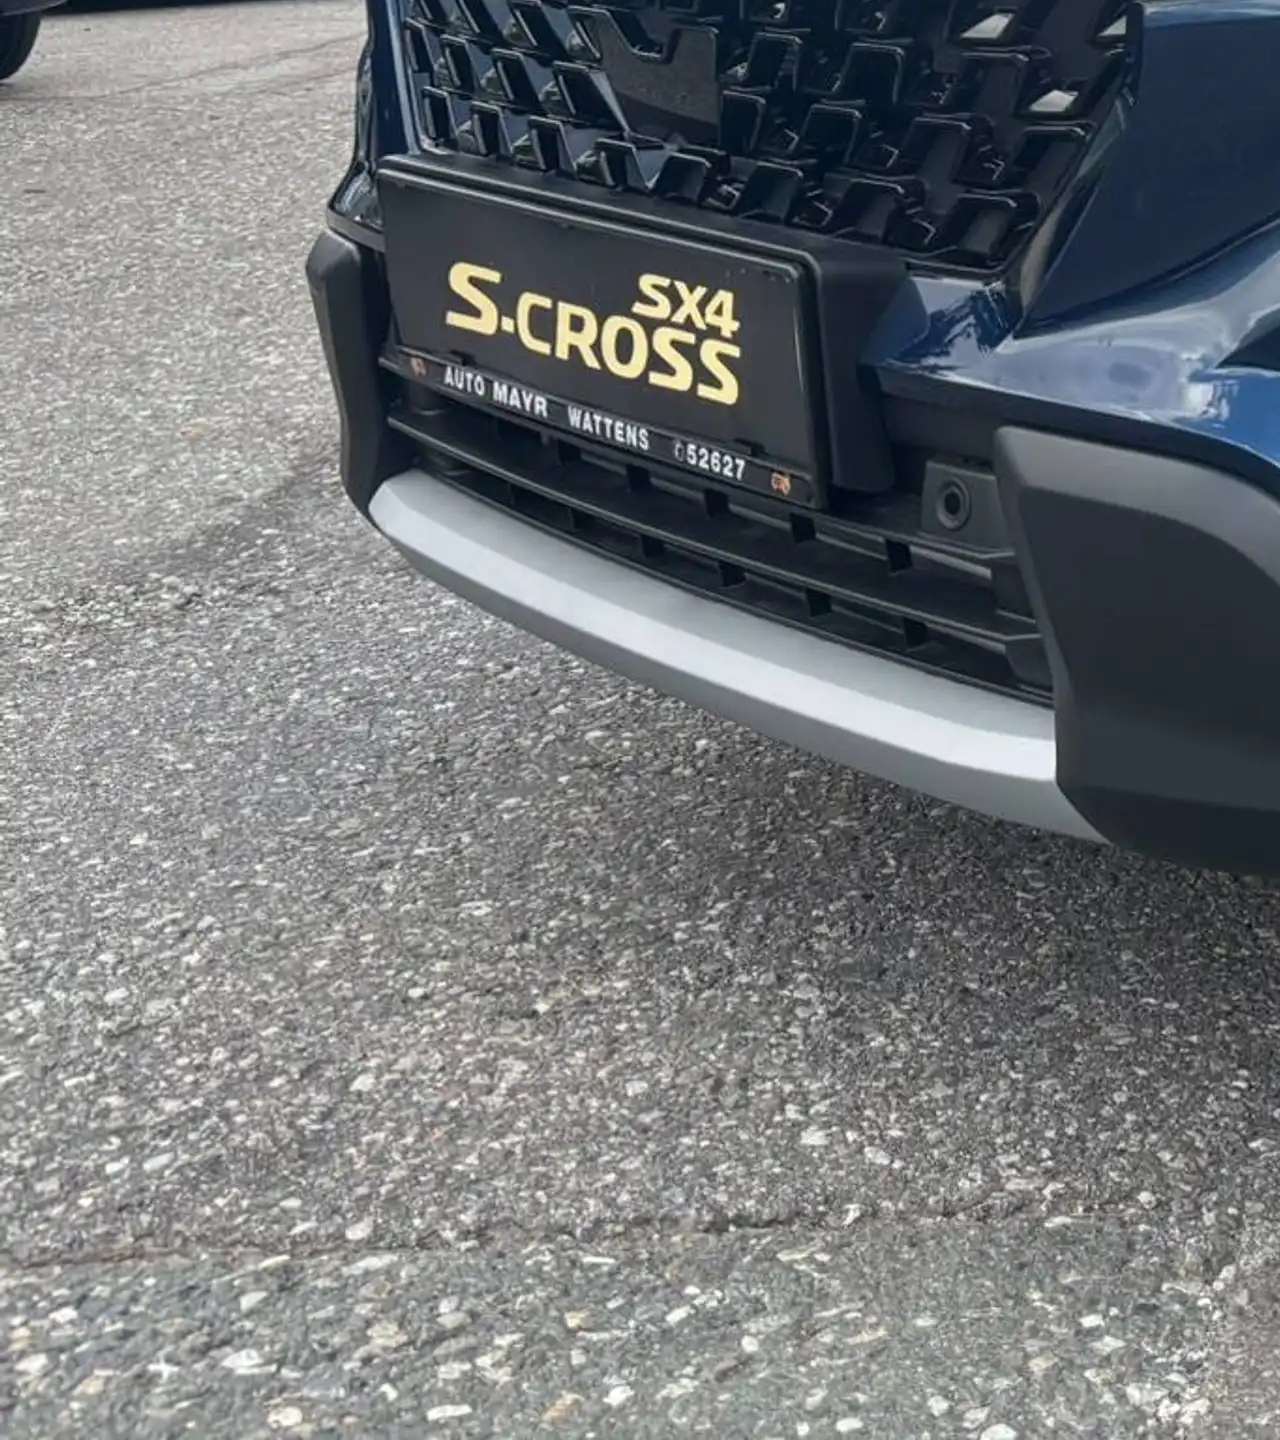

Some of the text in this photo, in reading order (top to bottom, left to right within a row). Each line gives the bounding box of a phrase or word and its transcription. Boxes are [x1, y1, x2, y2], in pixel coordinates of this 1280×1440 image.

[632, 273, 741, 338] SX4
[444, 366, 485, 396] AUTO
[493, 382, 548, 418] MAYR
[568, 406, 649, 451] WATTENS
